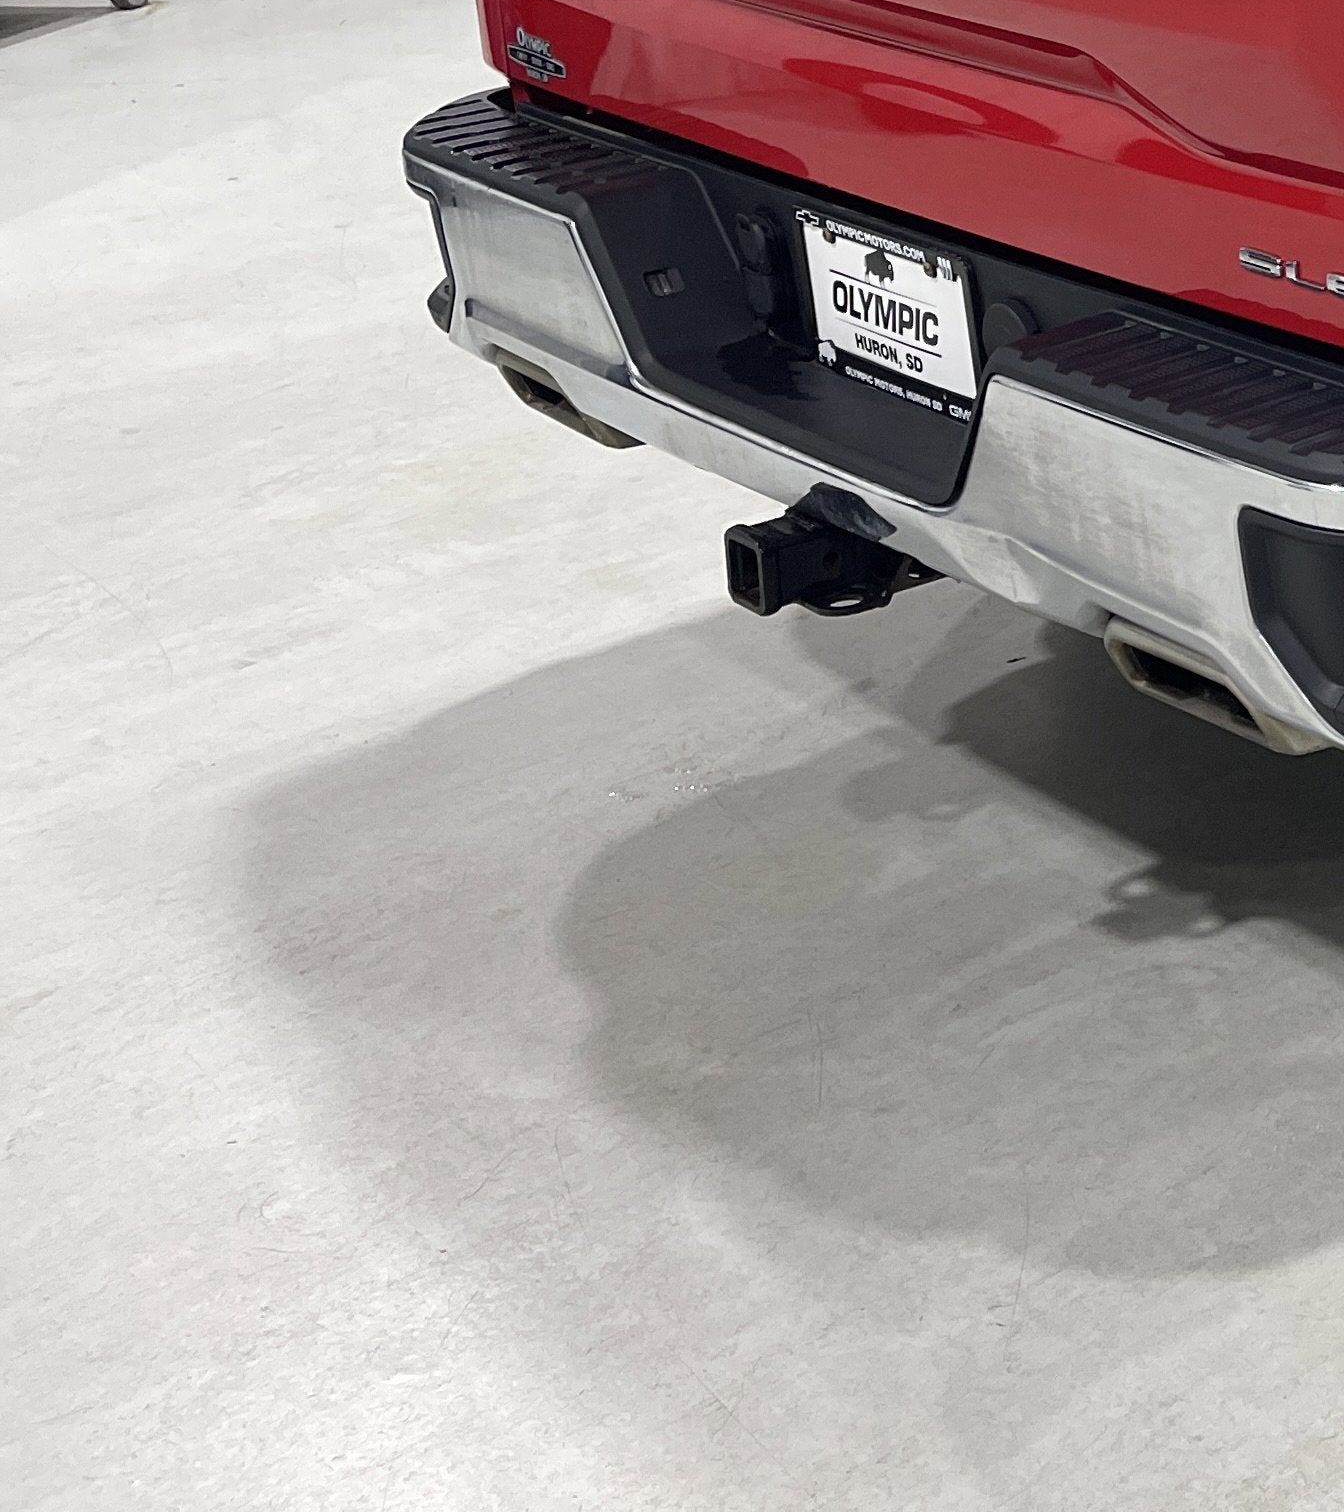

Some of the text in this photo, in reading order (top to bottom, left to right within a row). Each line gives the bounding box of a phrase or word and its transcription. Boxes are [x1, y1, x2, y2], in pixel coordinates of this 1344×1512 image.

[832, 280, 939, 346] OLYMPIC
[855, 333, 924, 373] HURON, SD
